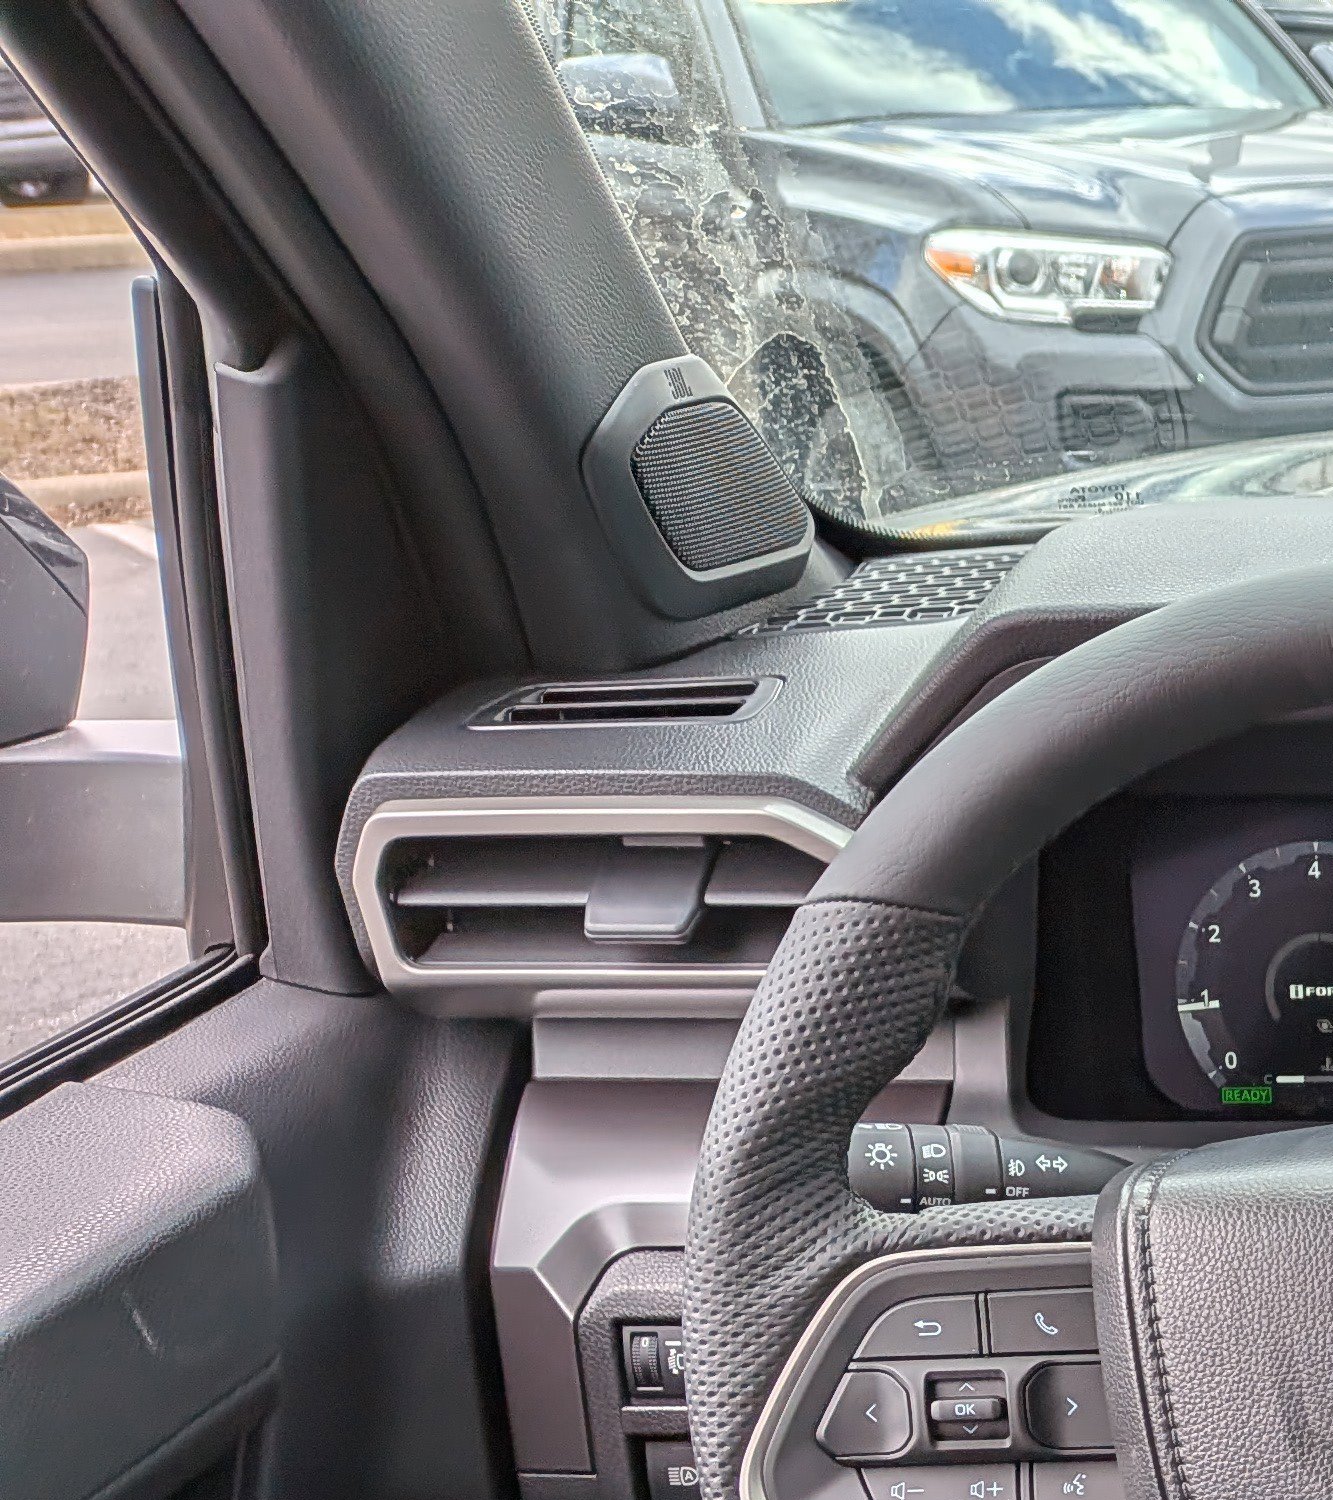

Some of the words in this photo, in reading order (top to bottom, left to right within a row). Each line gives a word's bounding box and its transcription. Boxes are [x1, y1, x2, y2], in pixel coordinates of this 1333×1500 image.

[1308, 861, 1321, 879] 4
[1249, 880, 1261, 897] 3
[1208, 925, 1221, 943] 2
[1225, 1051, 1237, 1069] 0
[1225, 1089, 1270, 1101] READY
[1005, 1187, 1029, 1197] OFF
[955, 1404, 976, 1416] OK
